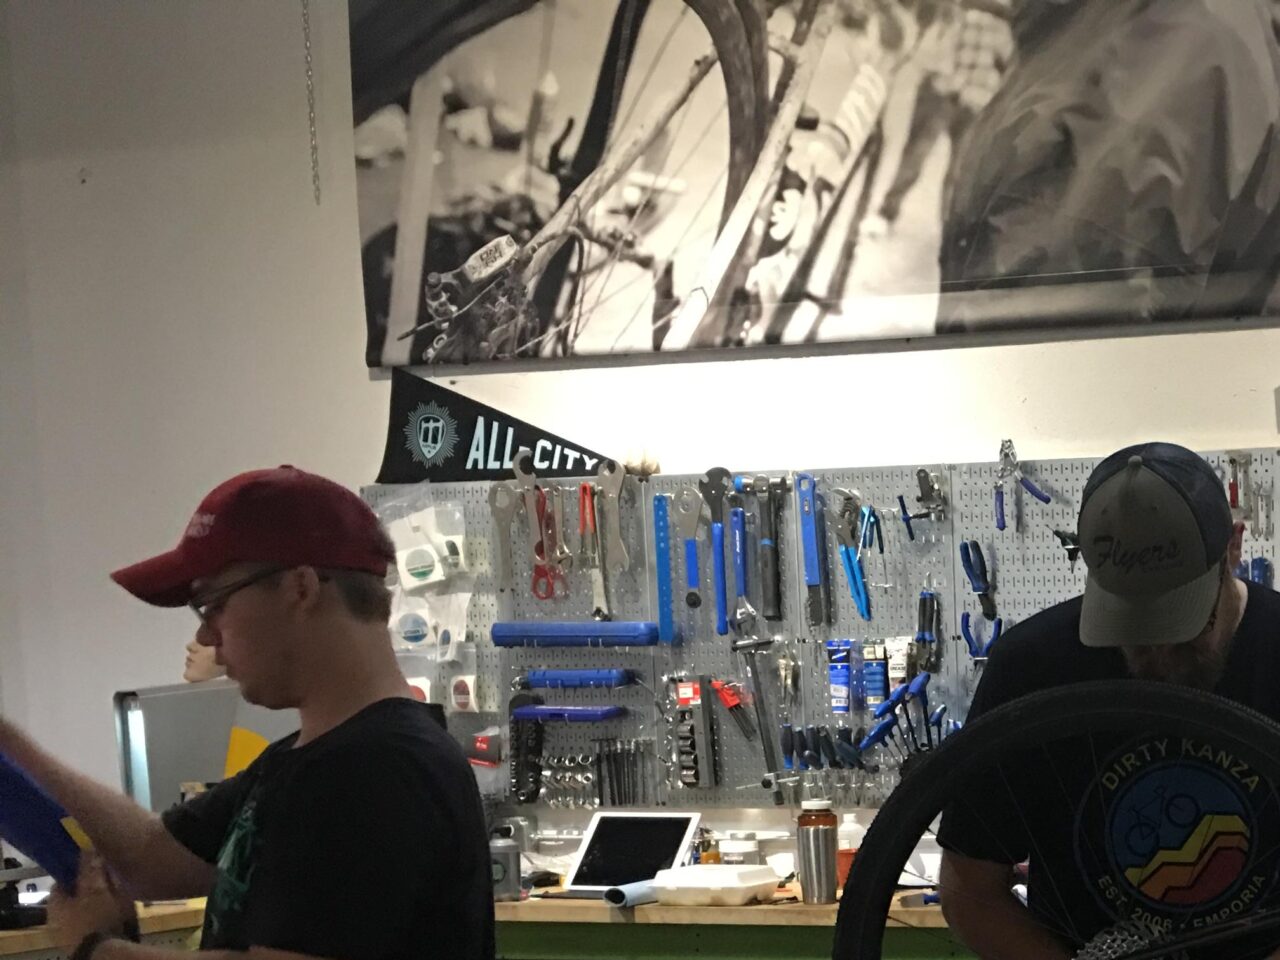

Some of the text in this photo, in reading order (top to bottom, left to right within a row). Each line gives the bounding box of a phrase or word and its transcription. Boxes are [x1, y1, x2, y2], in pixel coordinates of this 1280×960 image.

[1093, 535, 1182, 574] Flyers
[1101, 737, 1261, 793] DIRTY KANZA
[1098, 874, 1129, 907] EST
[1192, 874, 1267, 929] EMPORIA
